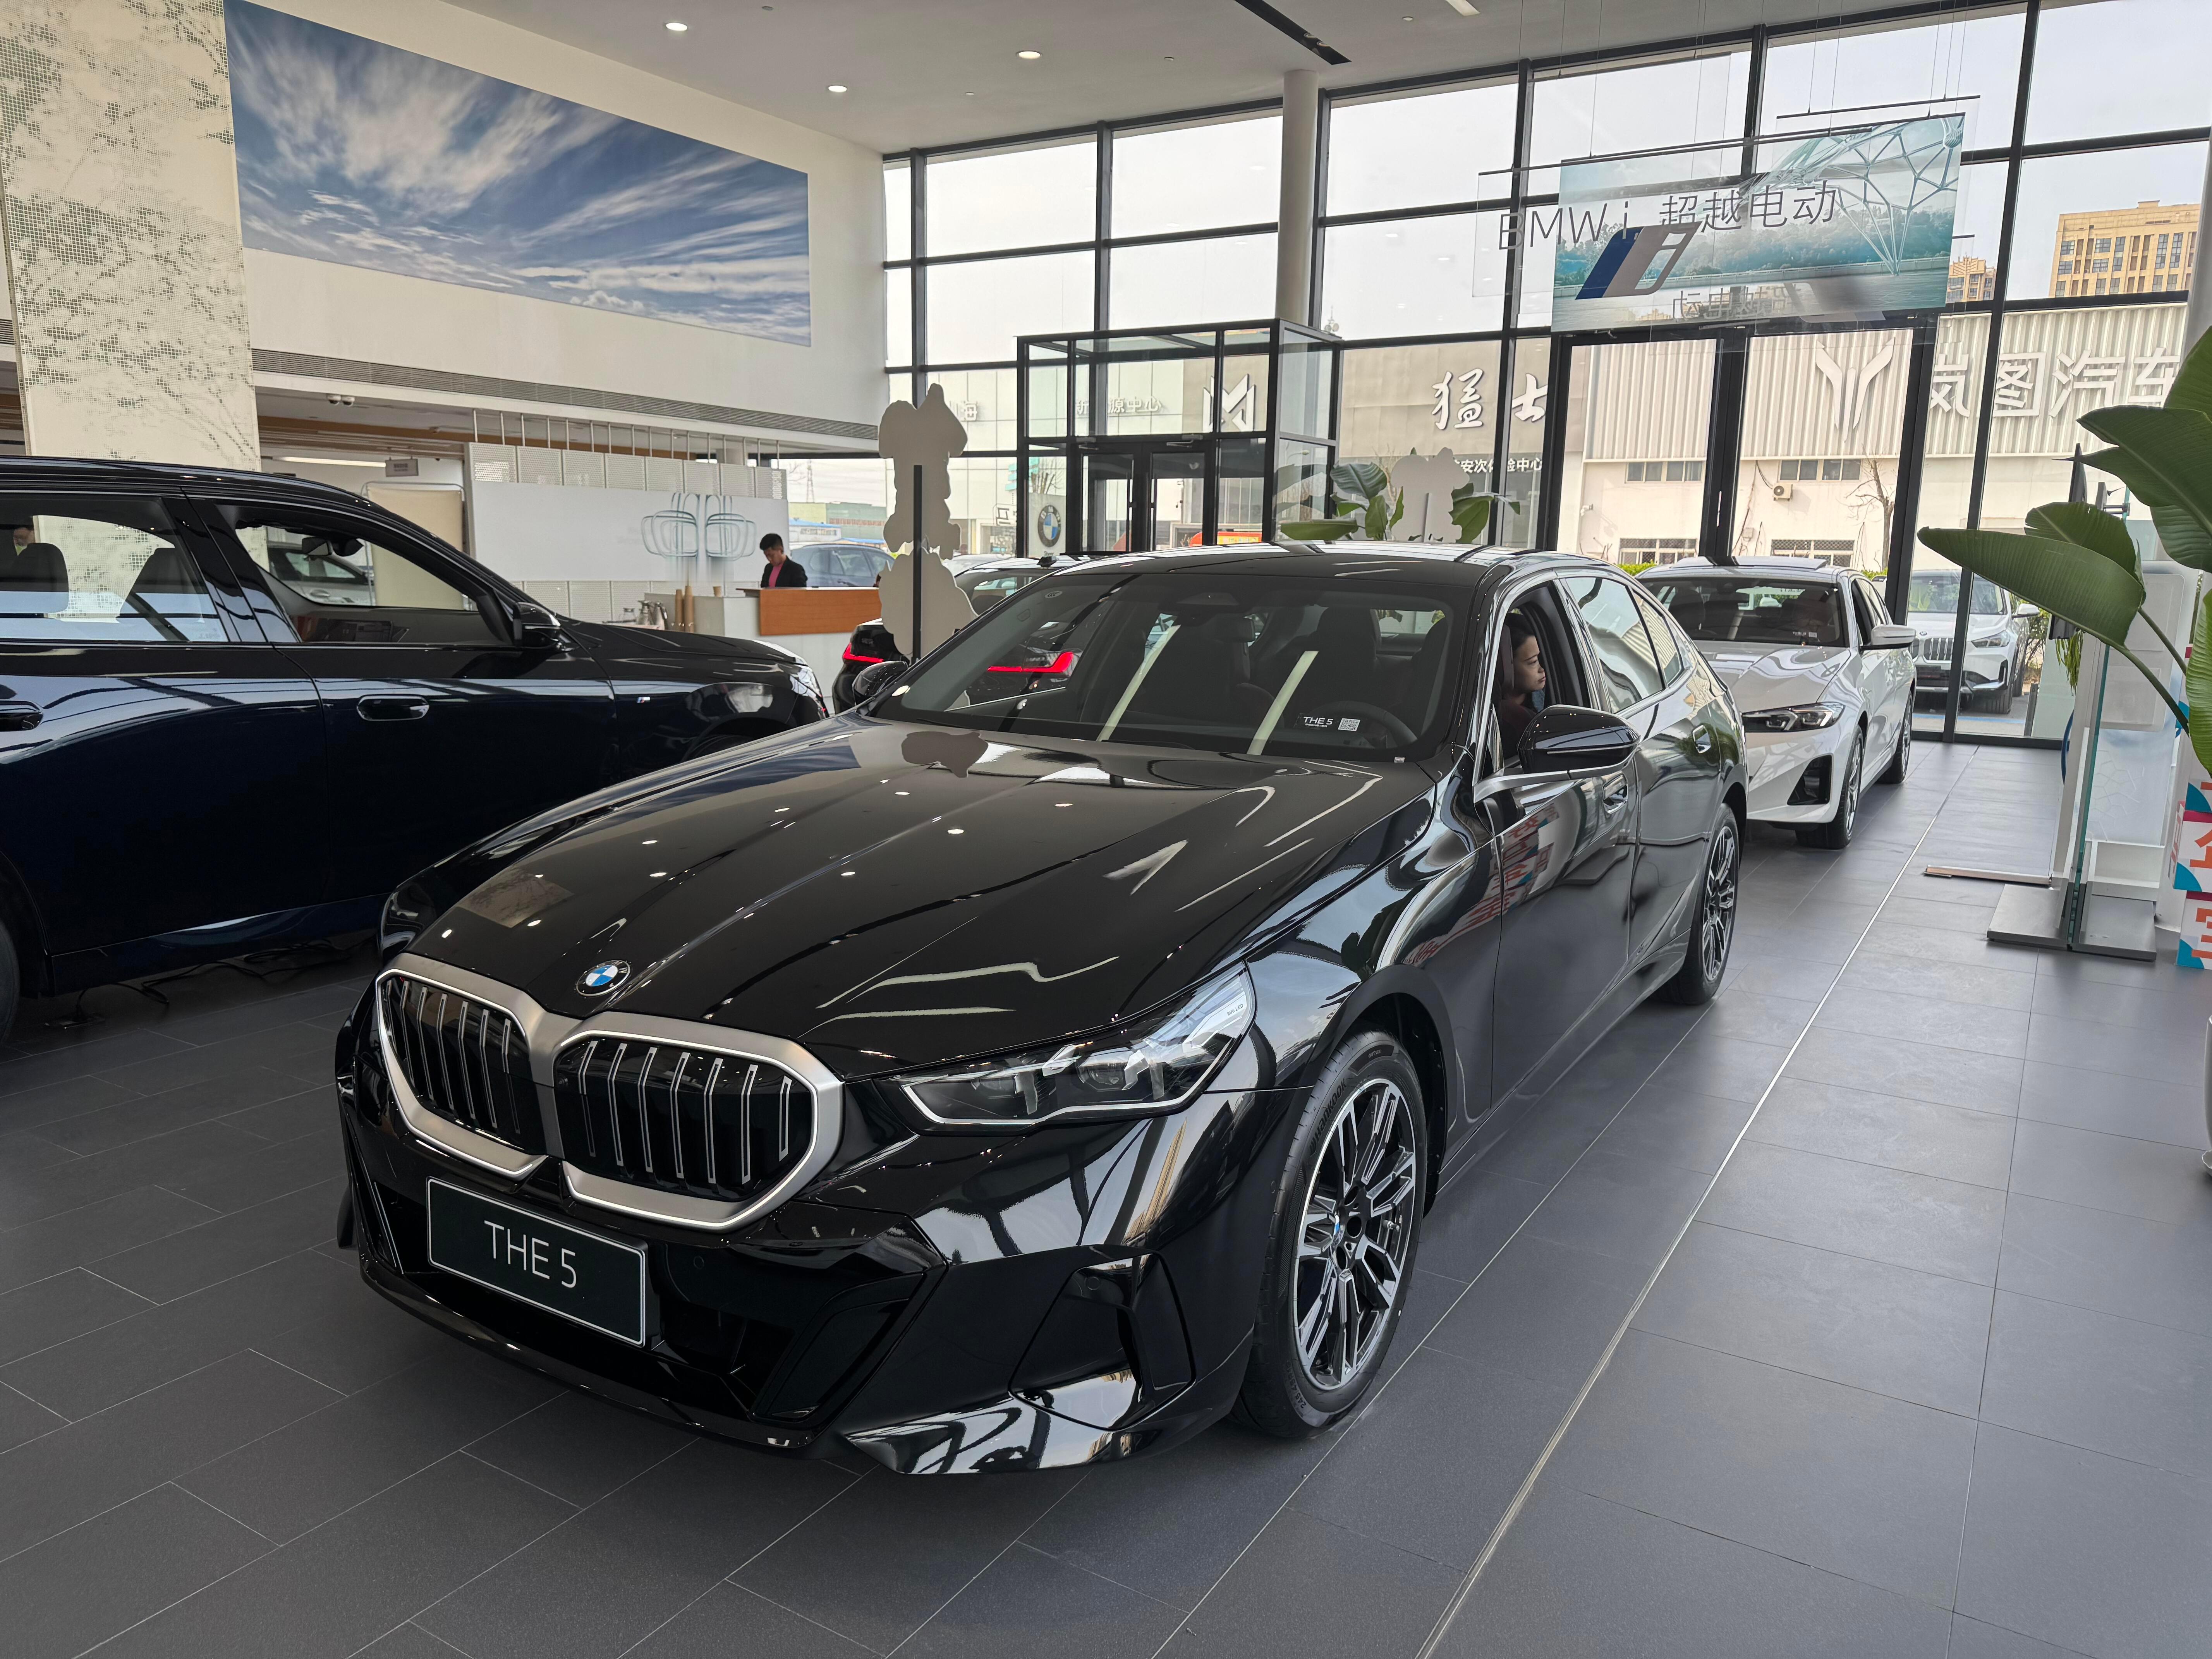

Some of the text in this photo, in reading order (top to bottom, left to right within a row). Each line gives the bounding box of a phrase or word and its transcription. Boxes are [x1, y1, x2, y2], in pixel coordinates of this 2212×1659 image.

[1499, 203, 1607, 249] BMW
[1659, 180, 1836, 233] 超越电动
[1078, 397, 1162, 414] 新源中心
[1432, 368, 1547, 430] 猛士
[1930, 347, 2180, 418] 岚图汽车
[1304, 716, 1325, 725] THE
[484, 1220, 577, 1288] THE 5
